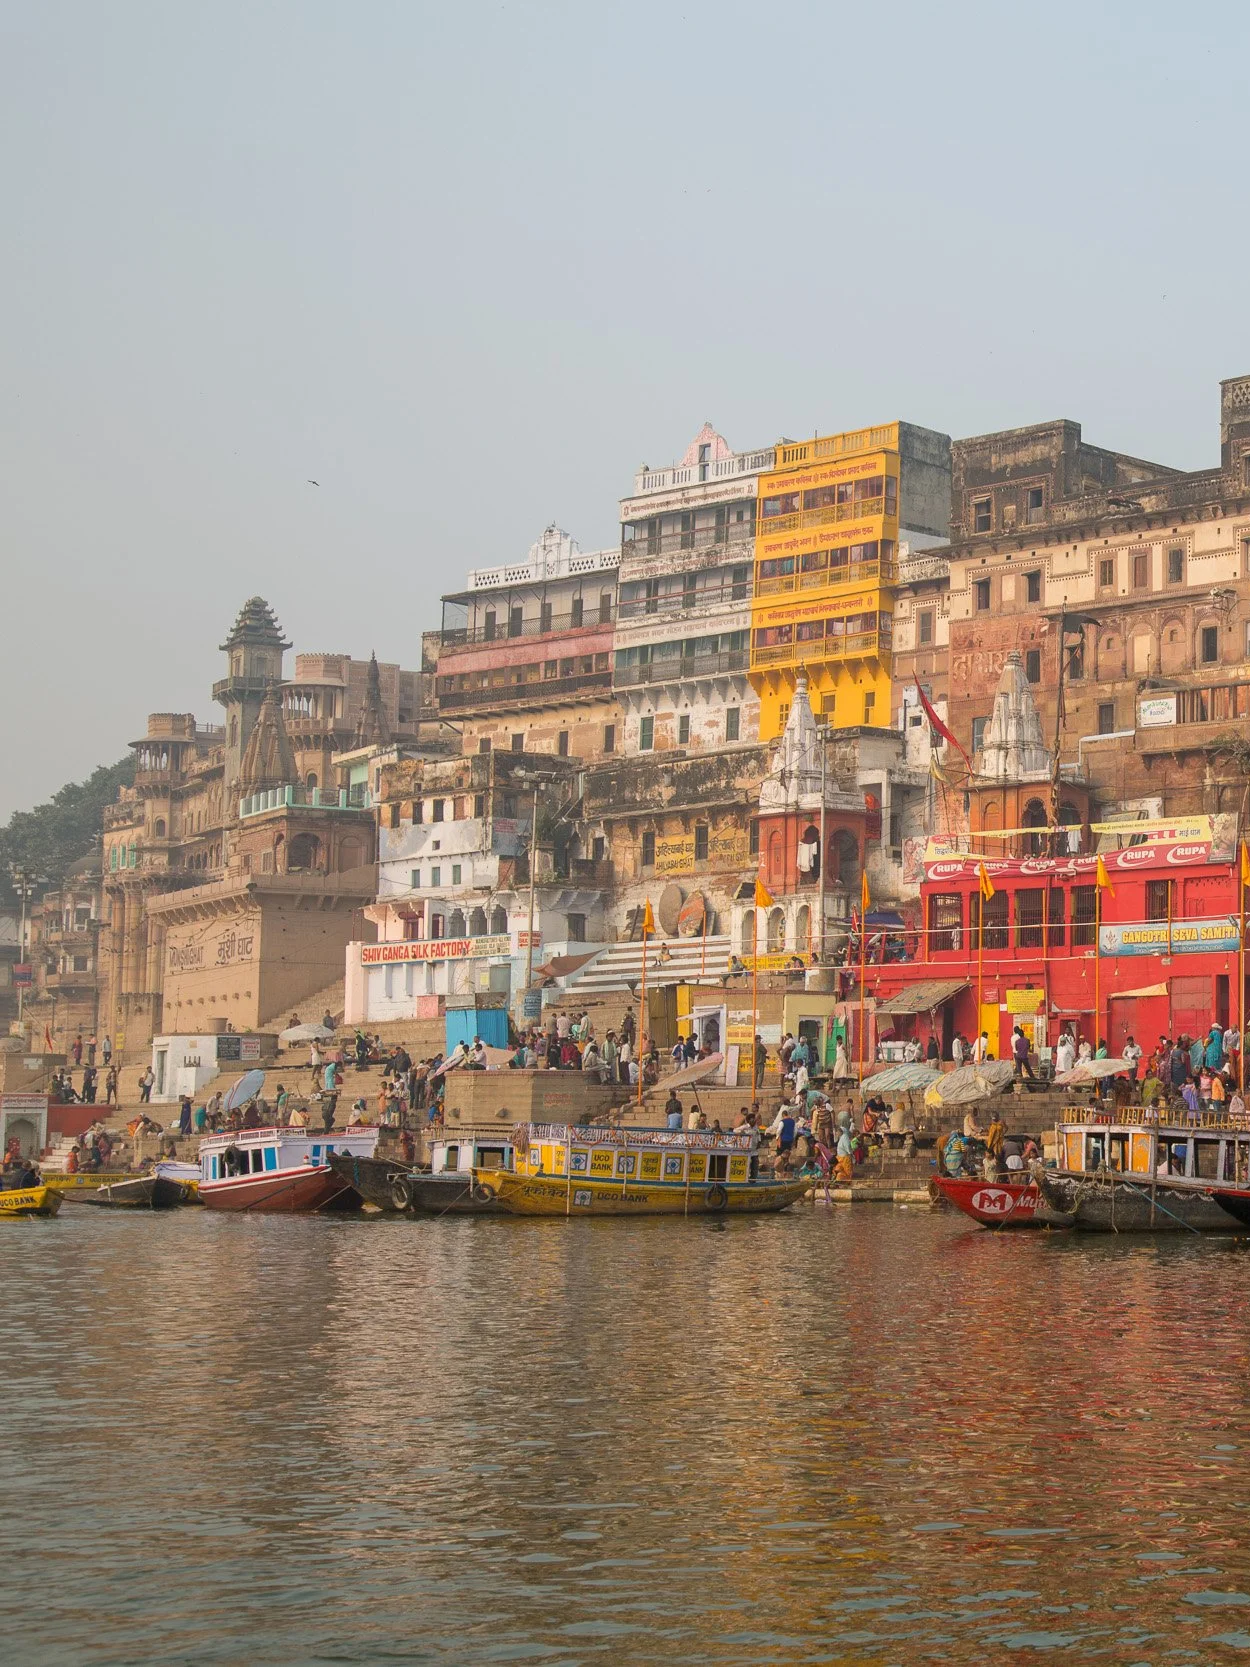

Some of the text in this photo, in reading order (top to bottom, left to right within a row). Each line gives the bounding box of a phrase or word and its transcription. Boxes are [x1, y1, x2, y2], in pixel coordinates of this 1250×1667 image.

[1126, 850, 1155, 860] RUPA
[1176, 846, 1206, 856] RUPA
[937, 863, 963, 873] RUPA
[1122, 926, 1236, 944] GANGOTRI SEVA SAMITI
[237, 936, 254, 956] घाट
[362, 947, 381, 963] SHIV
[382, 946, 409, 961] GANGA
[411, 943, 428, 959] SILK
[430, 940, 472, 957] FACTORY
[594, 1154, 610, 1162] UCO
[591, 1162, 612, 1171] BANK
[14, 1195, 37, 1205] BANK
[597, 1192, 649, 1203] UCO BANK
